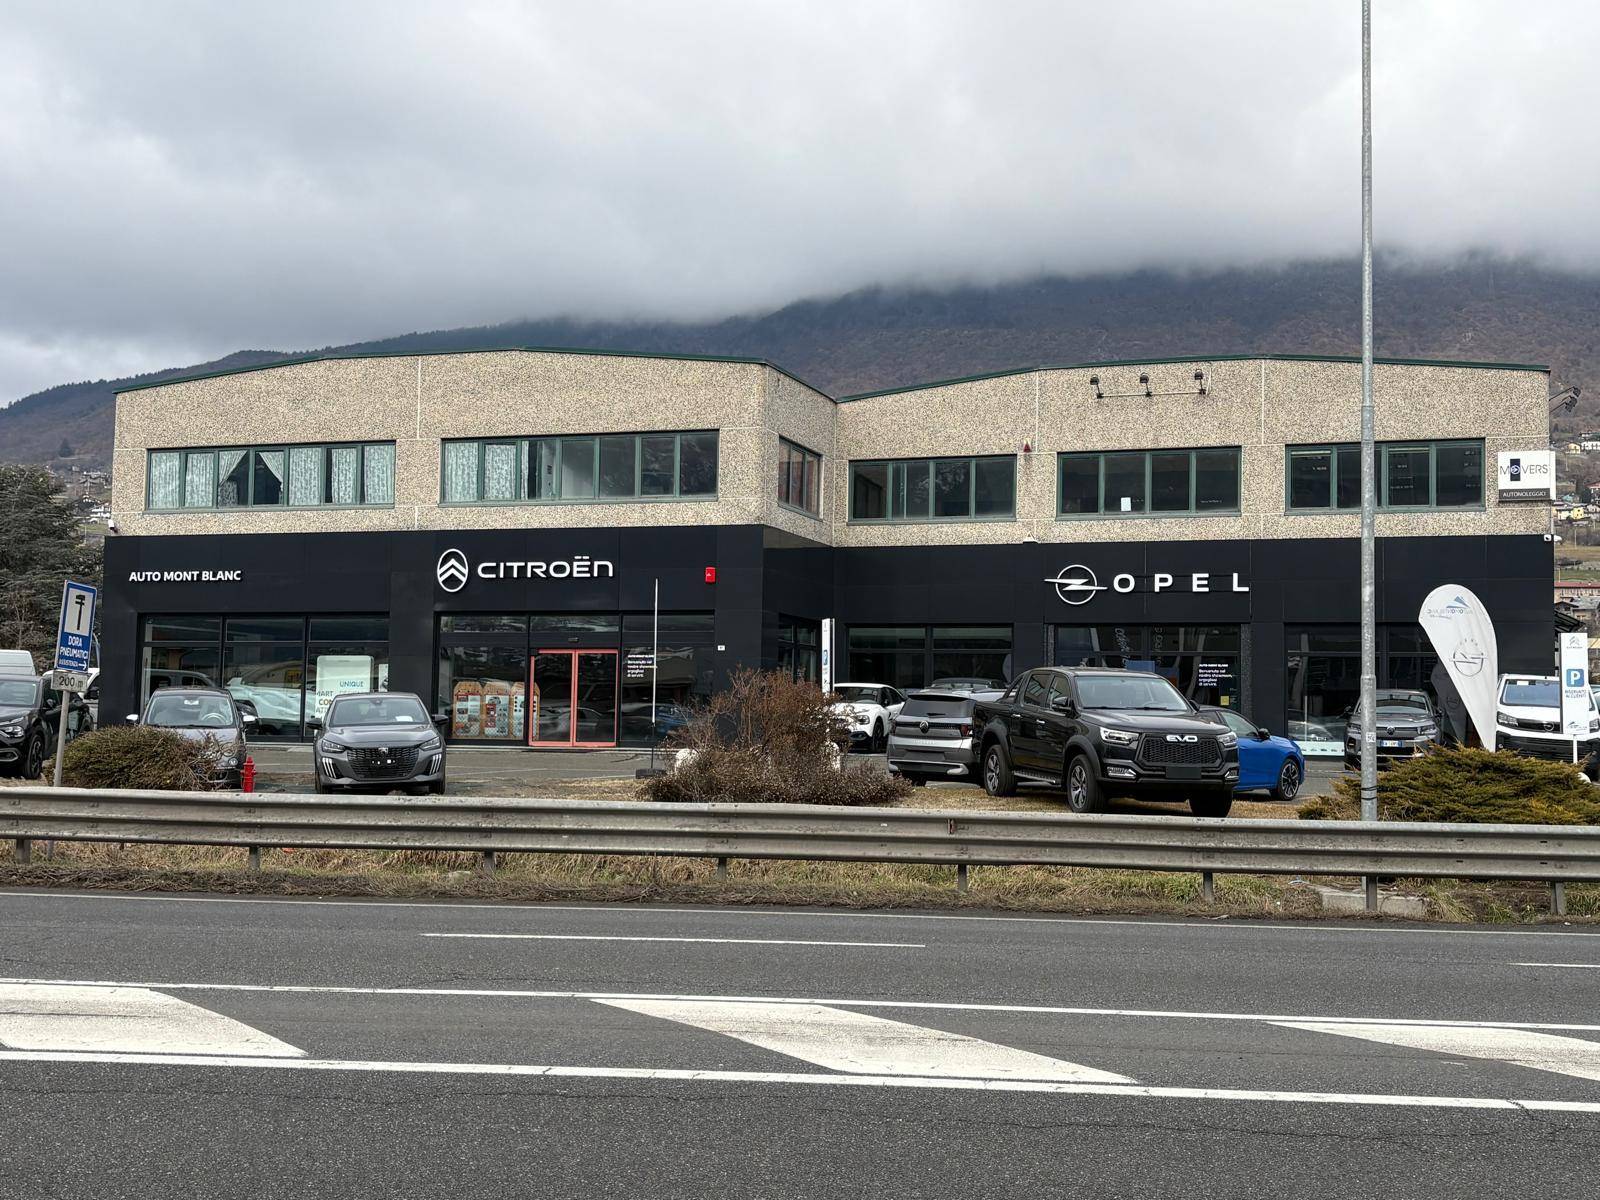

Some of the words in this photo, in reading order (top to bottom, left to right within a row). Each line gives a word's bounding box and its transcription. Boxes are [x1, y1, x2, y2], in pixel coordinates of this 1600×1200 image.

[1500, 464, 1549, 475] MOVERS
[129, 571, 161, 582] AUTO
[163, 571, 199, 581] MONT
[202, 570, 241, 581] BLANC
[1113, 572, 1250, 593] OPEL
[68, 635, 83, 647] DORA
[60, 646, 89, 660] PNEUMATICI
[59, 676, 75, 687] 200
[1570, 670, 1581, 685] P
[1166, 734, 1198, 743] EVO
